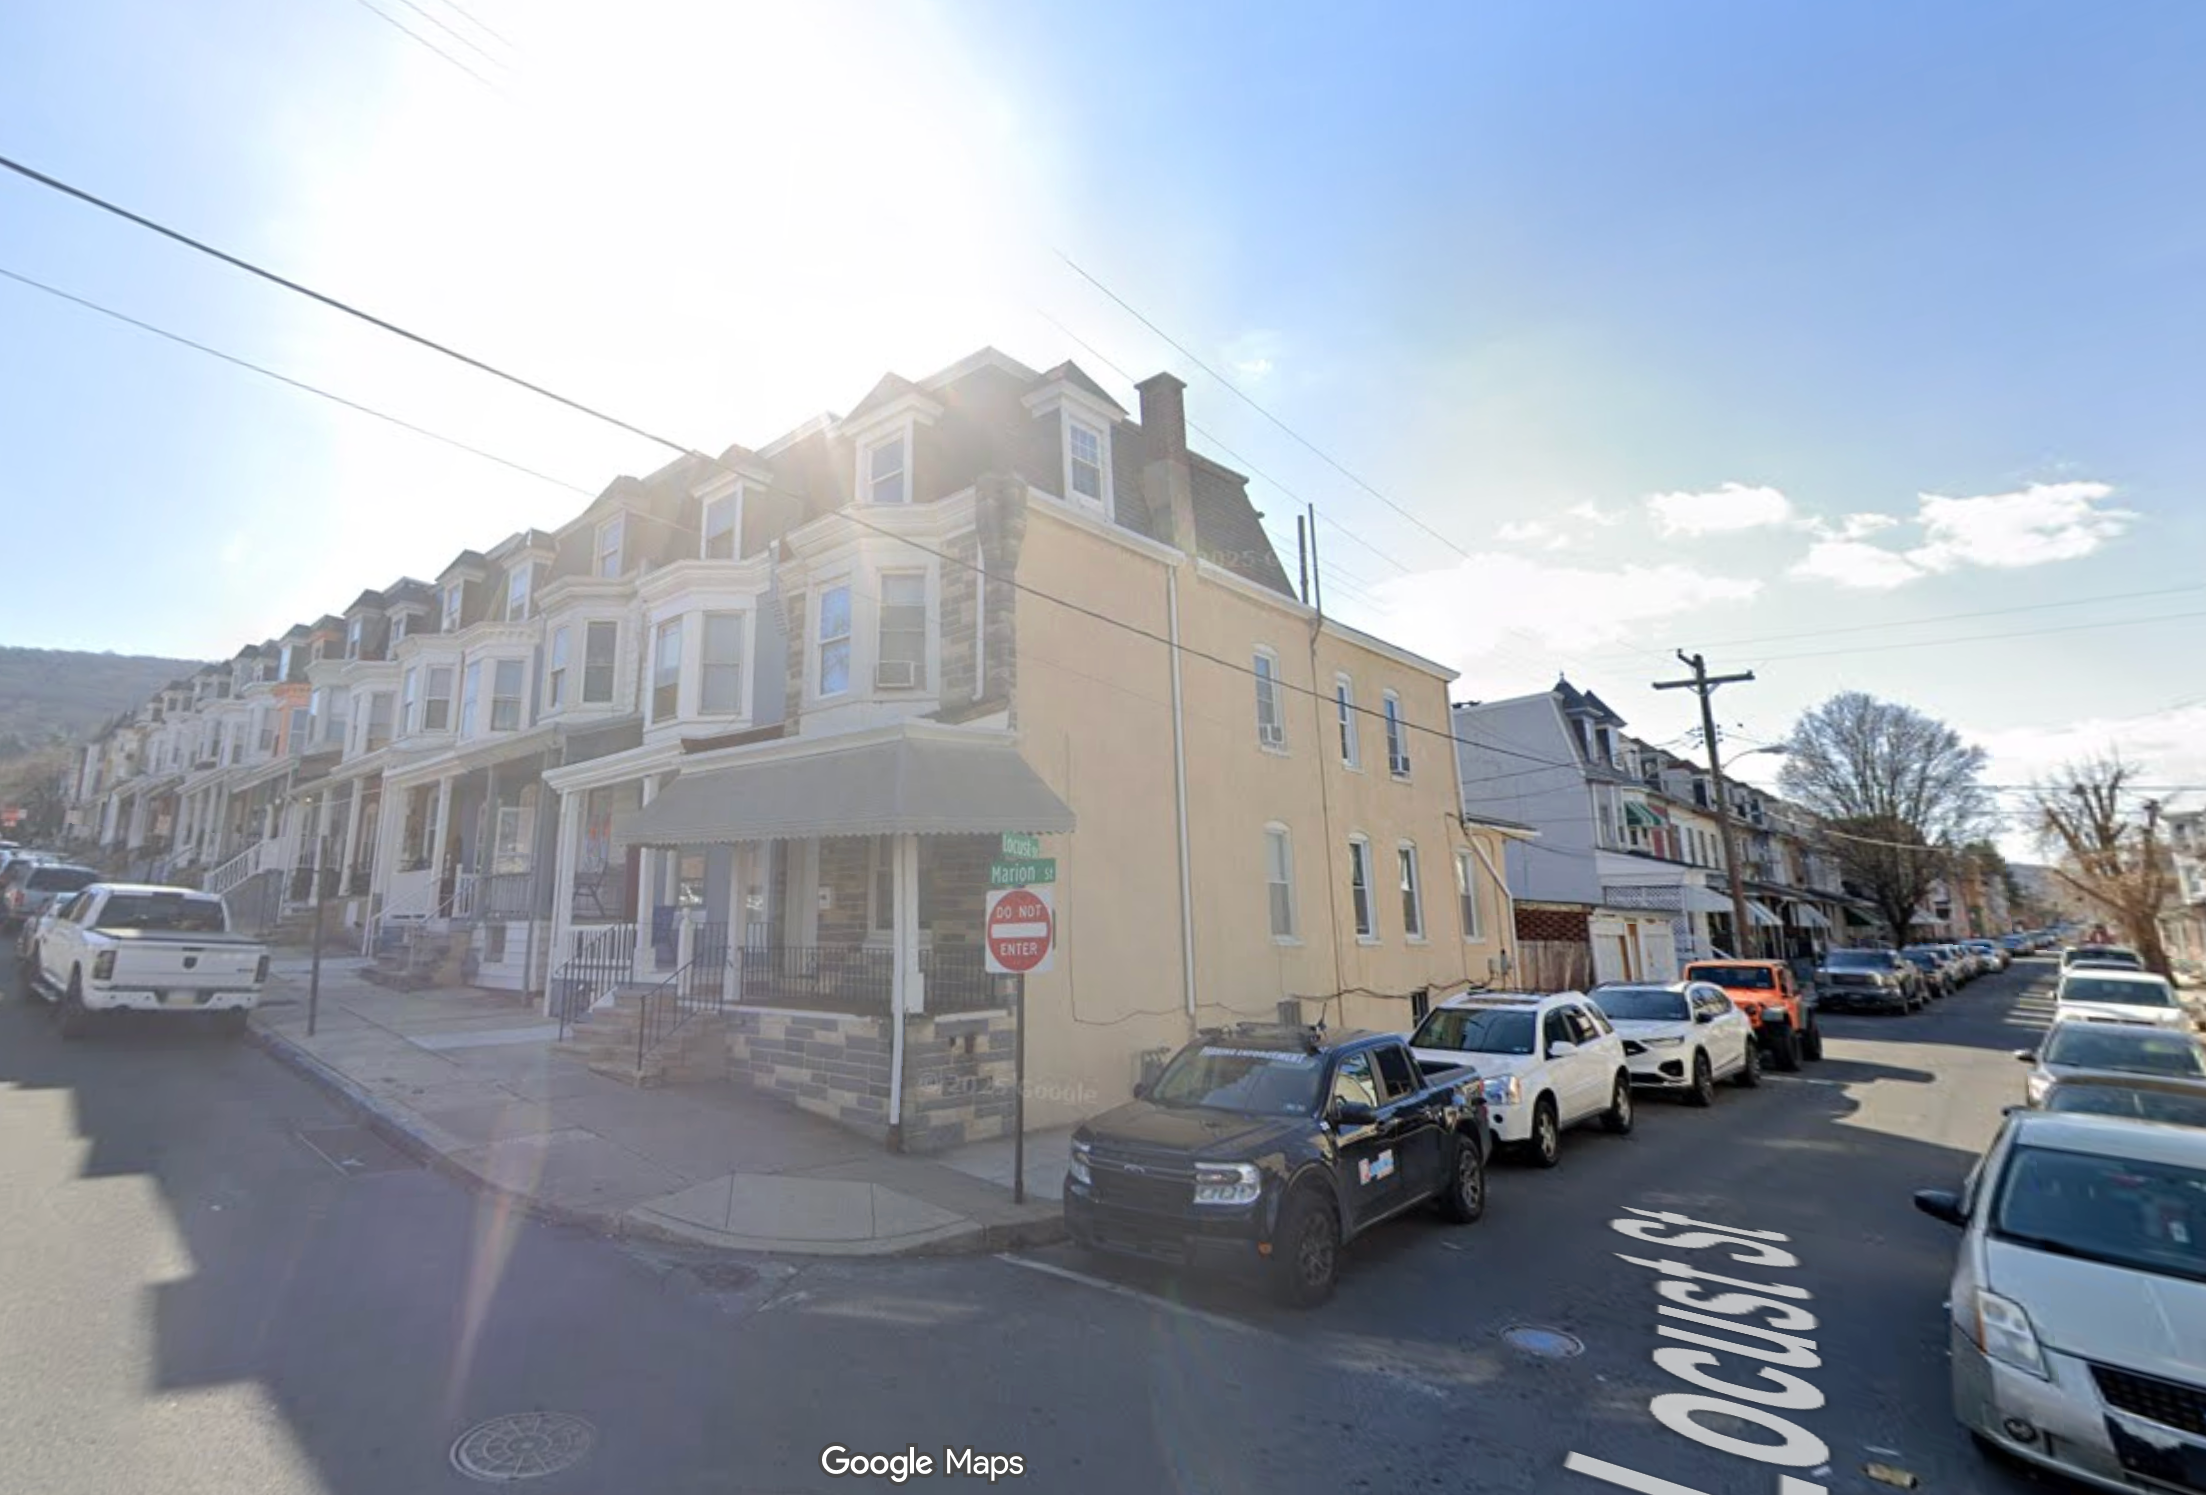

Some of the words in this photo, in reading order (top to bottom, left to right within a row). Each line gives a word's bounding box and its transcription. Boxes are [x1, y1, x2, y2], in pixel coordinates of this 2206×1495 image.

[1002, 834, 1032, 857] Locust
[991, 863, 1036, 884] Marion
[1044, 866, 1054, 881] St
[996, 906, 1012, 919] DO
[1019, 904, 1043, 918] NOT
[1000, 942, 1038, 956] ENTER
